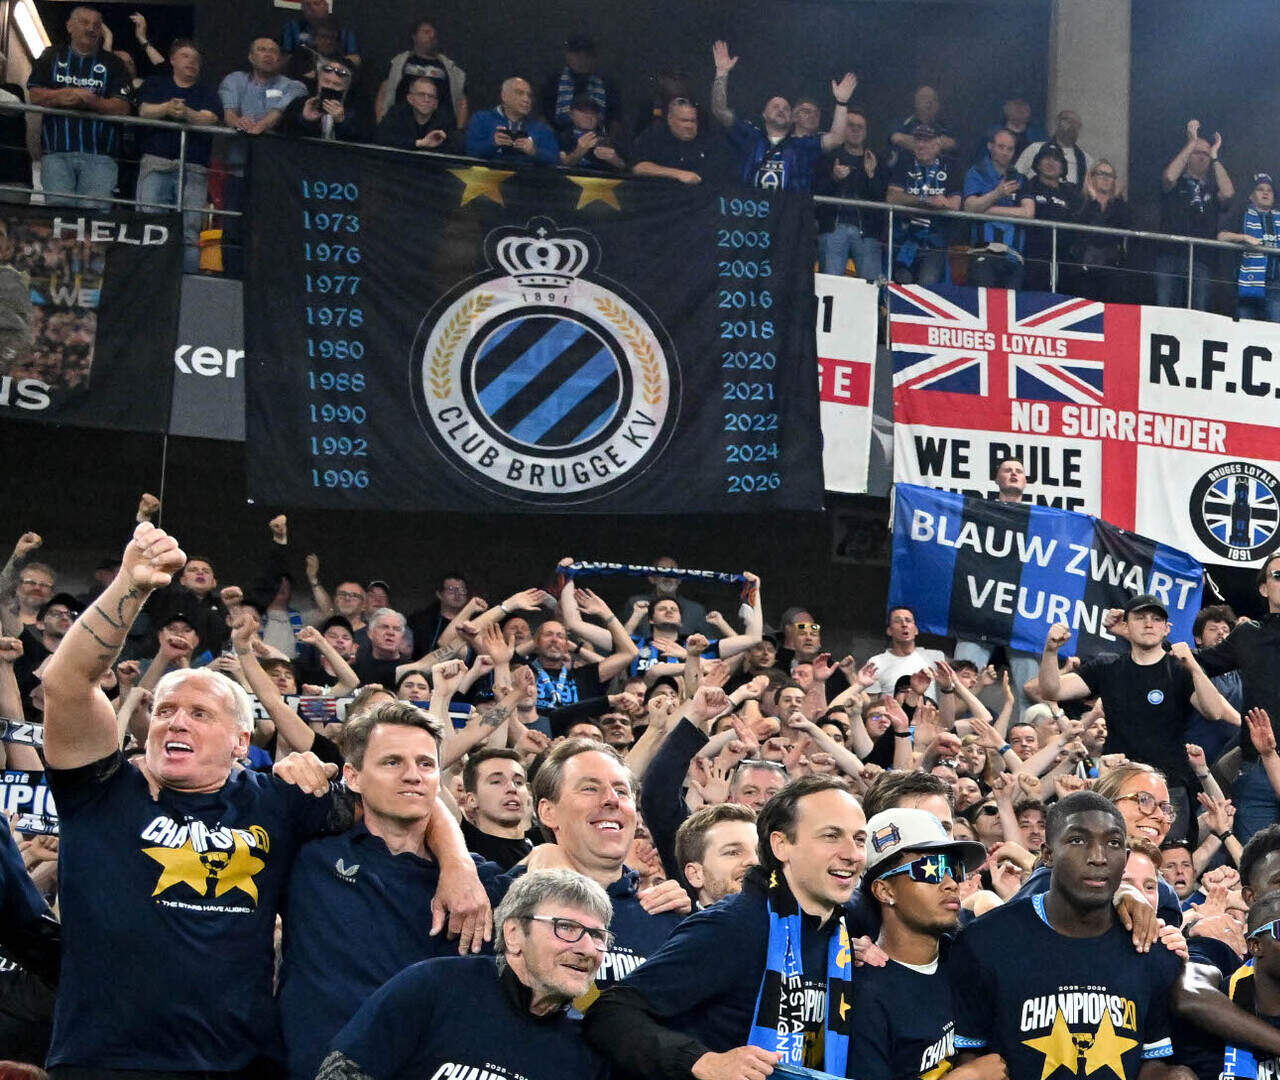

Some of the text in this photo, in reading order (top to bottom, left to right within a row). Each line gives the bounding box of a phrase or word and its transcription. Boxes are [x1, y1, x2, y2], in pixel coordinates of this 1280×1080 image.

[303, 180, 358, 201] 1920
[718, 197, 770, 218] 1998
[53, 217, 169, 245] HELD
[303, 211, 360, 233] 1973
[717, 229, 771, 249] 2003
[305, 243, 361, 264] 1976
[718, 260, 773, 279] 2005
[306, 274, 361, 295] 1977
[521, 291, 569, 303] 1891
[719, 290, 773, 309] 2016
[306, 307, 364, 327] 1978
[720, 320, 775, 340] 2018
[307, 339, 364, 360] 1980
[928, 326, 1068, 357] BRUGES LOYALS
[722, 351, 777, 370] 2020
[308, 371, 366, 392] 1988
[723, 382, 775, 401] 2021
[309, 404, 367, 425] 1990
[724, 413, 778, 432] 2022
[1011, 401, 1228, 453] NO SURRENDER
[310, 436, 368, 457] 1992
[438, 405, 658, 488] CLUB BRUGGE KV
[726, 443, 780, 463] 2024
[914, 436, 971, 480] WE
[312, 469, 370, 489] 1996
[727, 474, 781, 493] 2026
[1208, 463, 1278, 488] BRUGES LOYALS
[910, 509, 1198, 610] BLAUW ZWART
[1228, 548, 1251, 561] 1891
